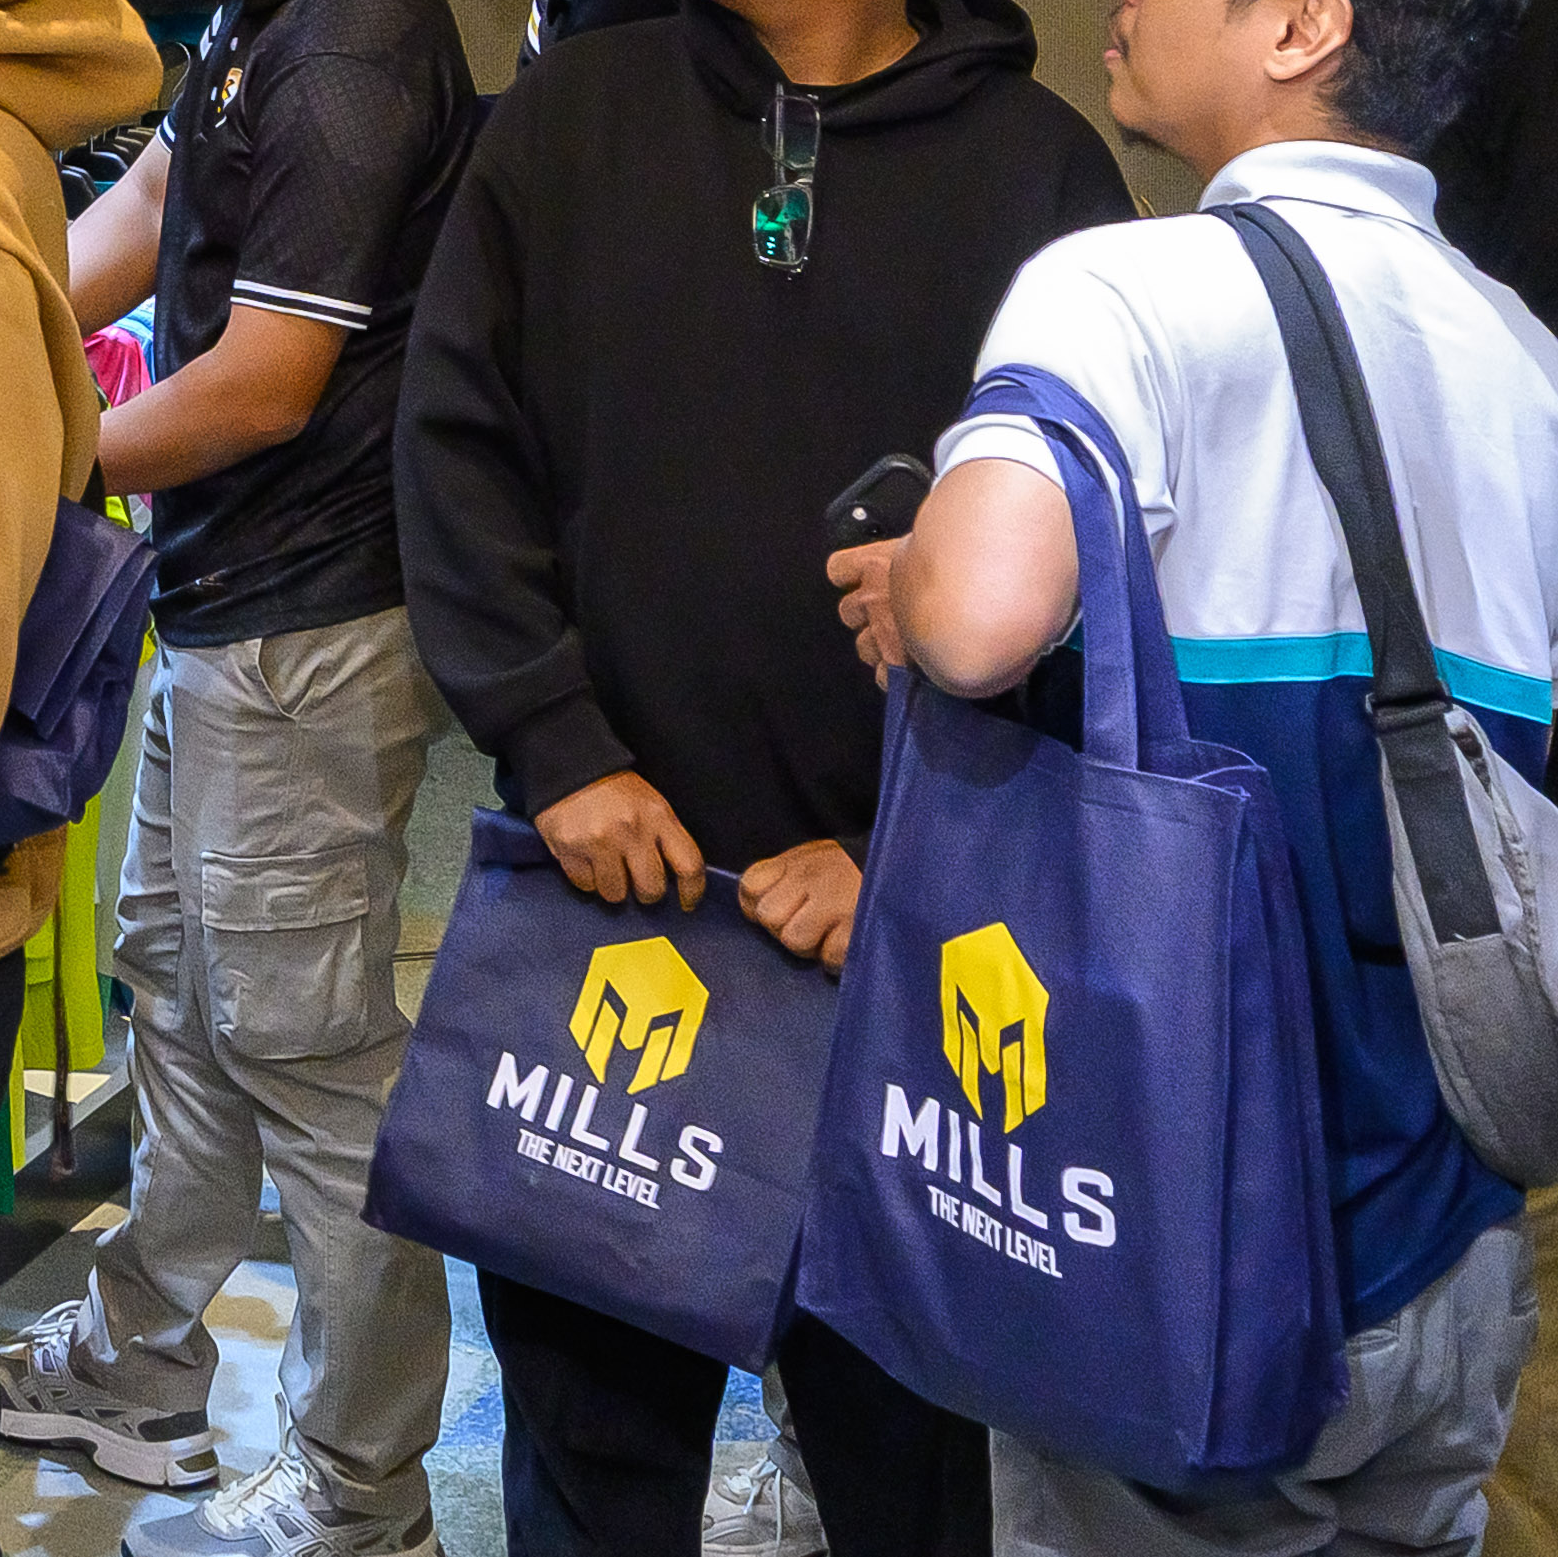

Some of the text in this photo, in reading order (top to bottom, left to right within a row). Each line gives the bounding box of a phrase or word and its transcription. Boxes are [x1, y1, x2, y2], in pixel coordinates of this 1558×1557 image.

[486, 1051, 724, 1191] MILLS
[516, 1128, 661, 1210] THE NEXT LEVEL
[881, 1082, 1117, 1247] MILLS
[926, 1184, 1063, 1278] THE NEXT LEVEL
